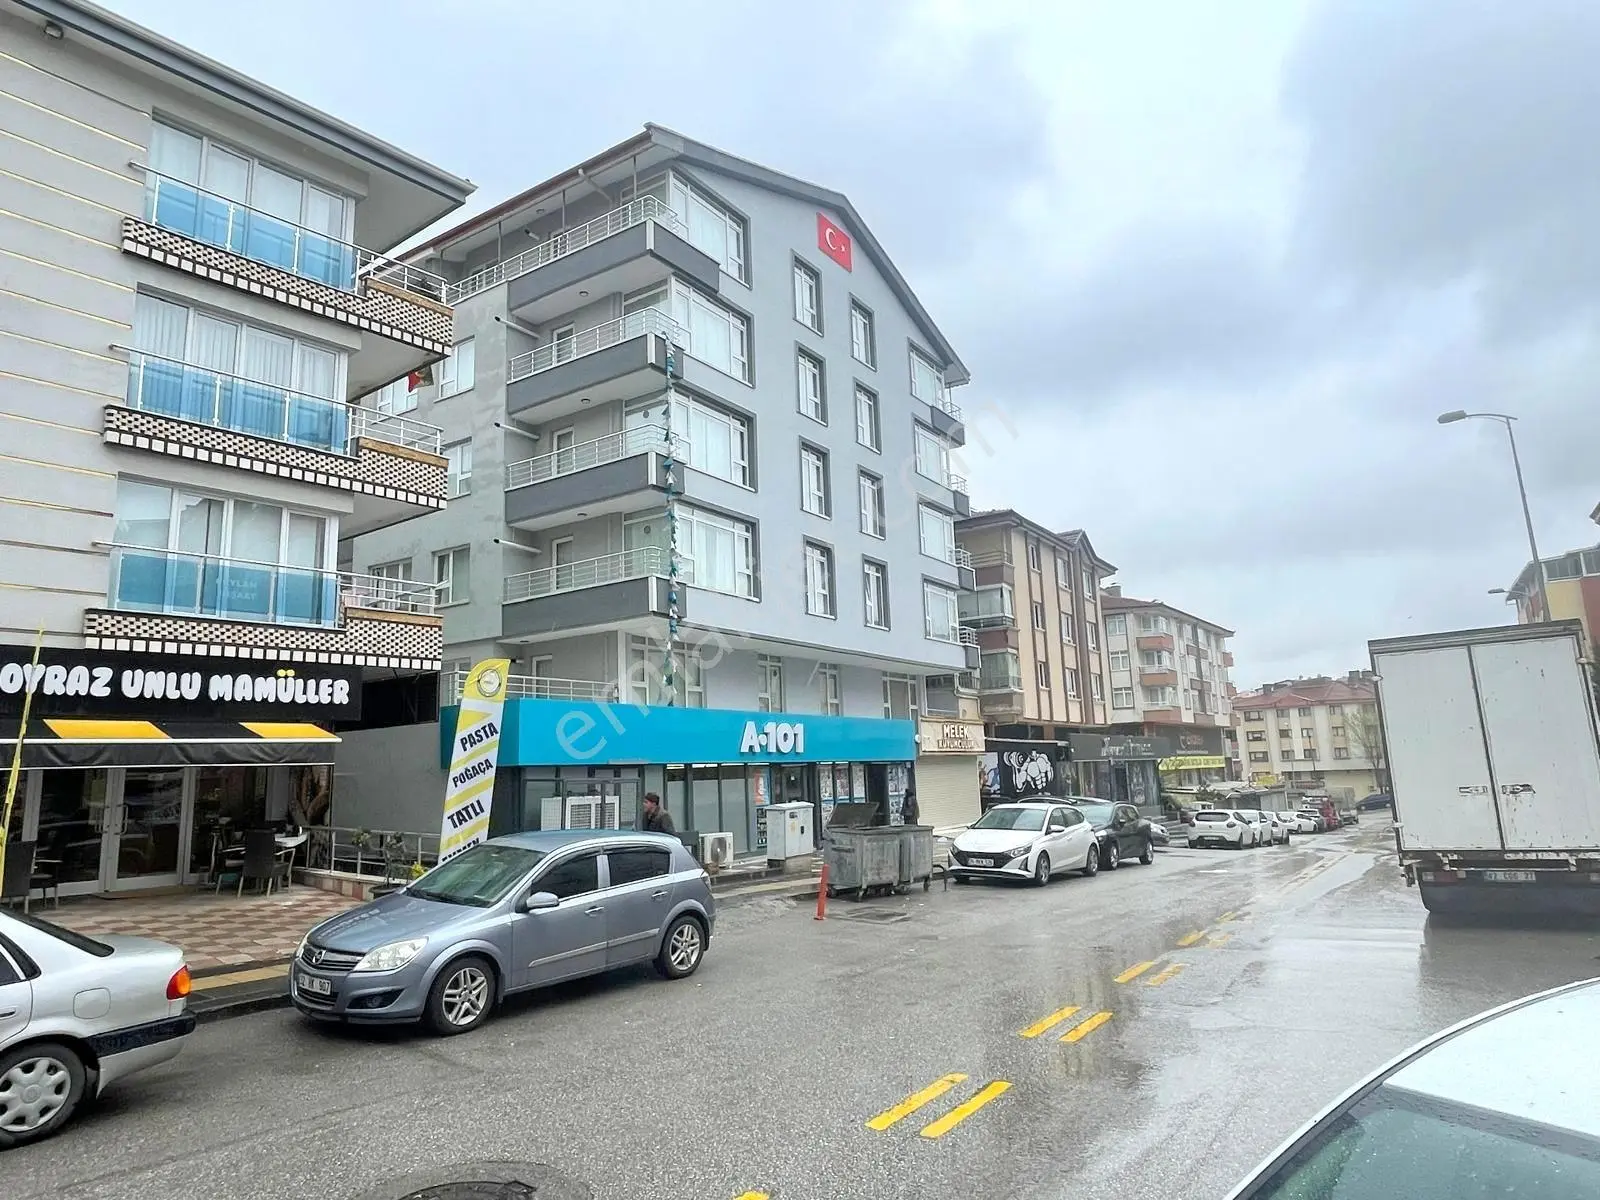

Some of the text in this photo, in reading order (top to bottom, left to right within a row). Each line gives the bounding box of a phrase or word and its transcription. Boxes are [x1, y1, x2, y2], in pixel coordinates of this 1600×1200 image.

[121, 669, 201, 699] UNLU
[208, 669, 350, 704] MAMÜLLER
[460, 722, 499, 752] PASTA
[943, 723, 969, 739] MELEK
[452, 758, 494, 788] POĞAÇA
[447, 799, 485, 829] TATLI
